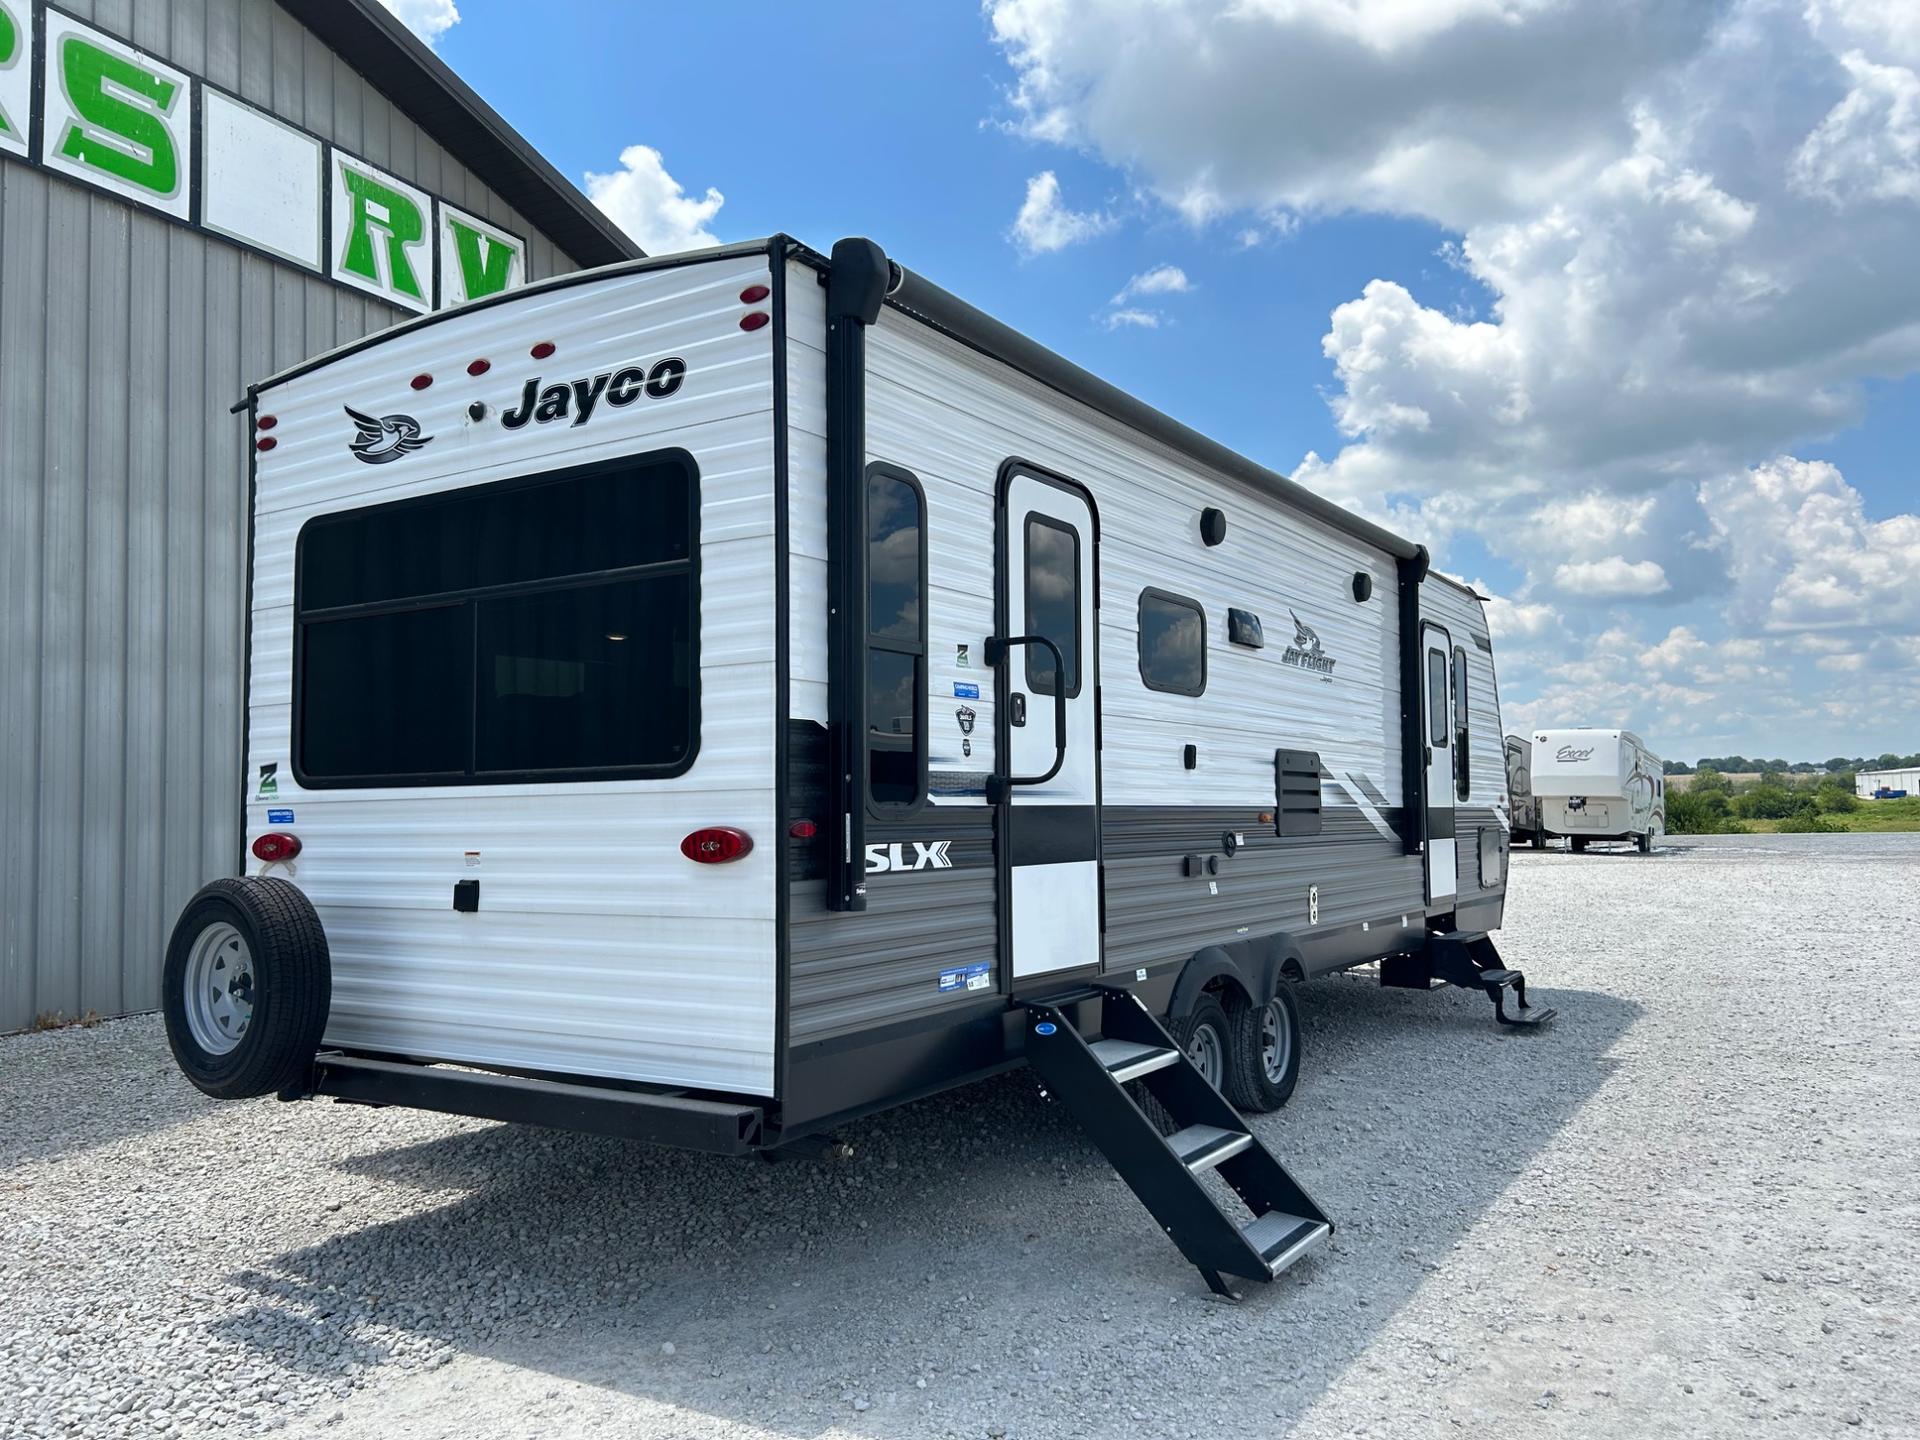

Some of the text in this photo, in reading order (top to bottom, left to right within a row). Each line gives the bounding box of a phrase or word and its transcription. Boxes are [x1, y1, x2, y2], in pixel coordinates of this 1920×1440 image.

[0, 0, 520, 305] S RV
[501, 357, 687, 430] Jayco
[1281, 645, 1337, 674] JAY FLIGHT
[1556, 745, 1594, 761] Excel
[865, 841, 952, 873] SLX
